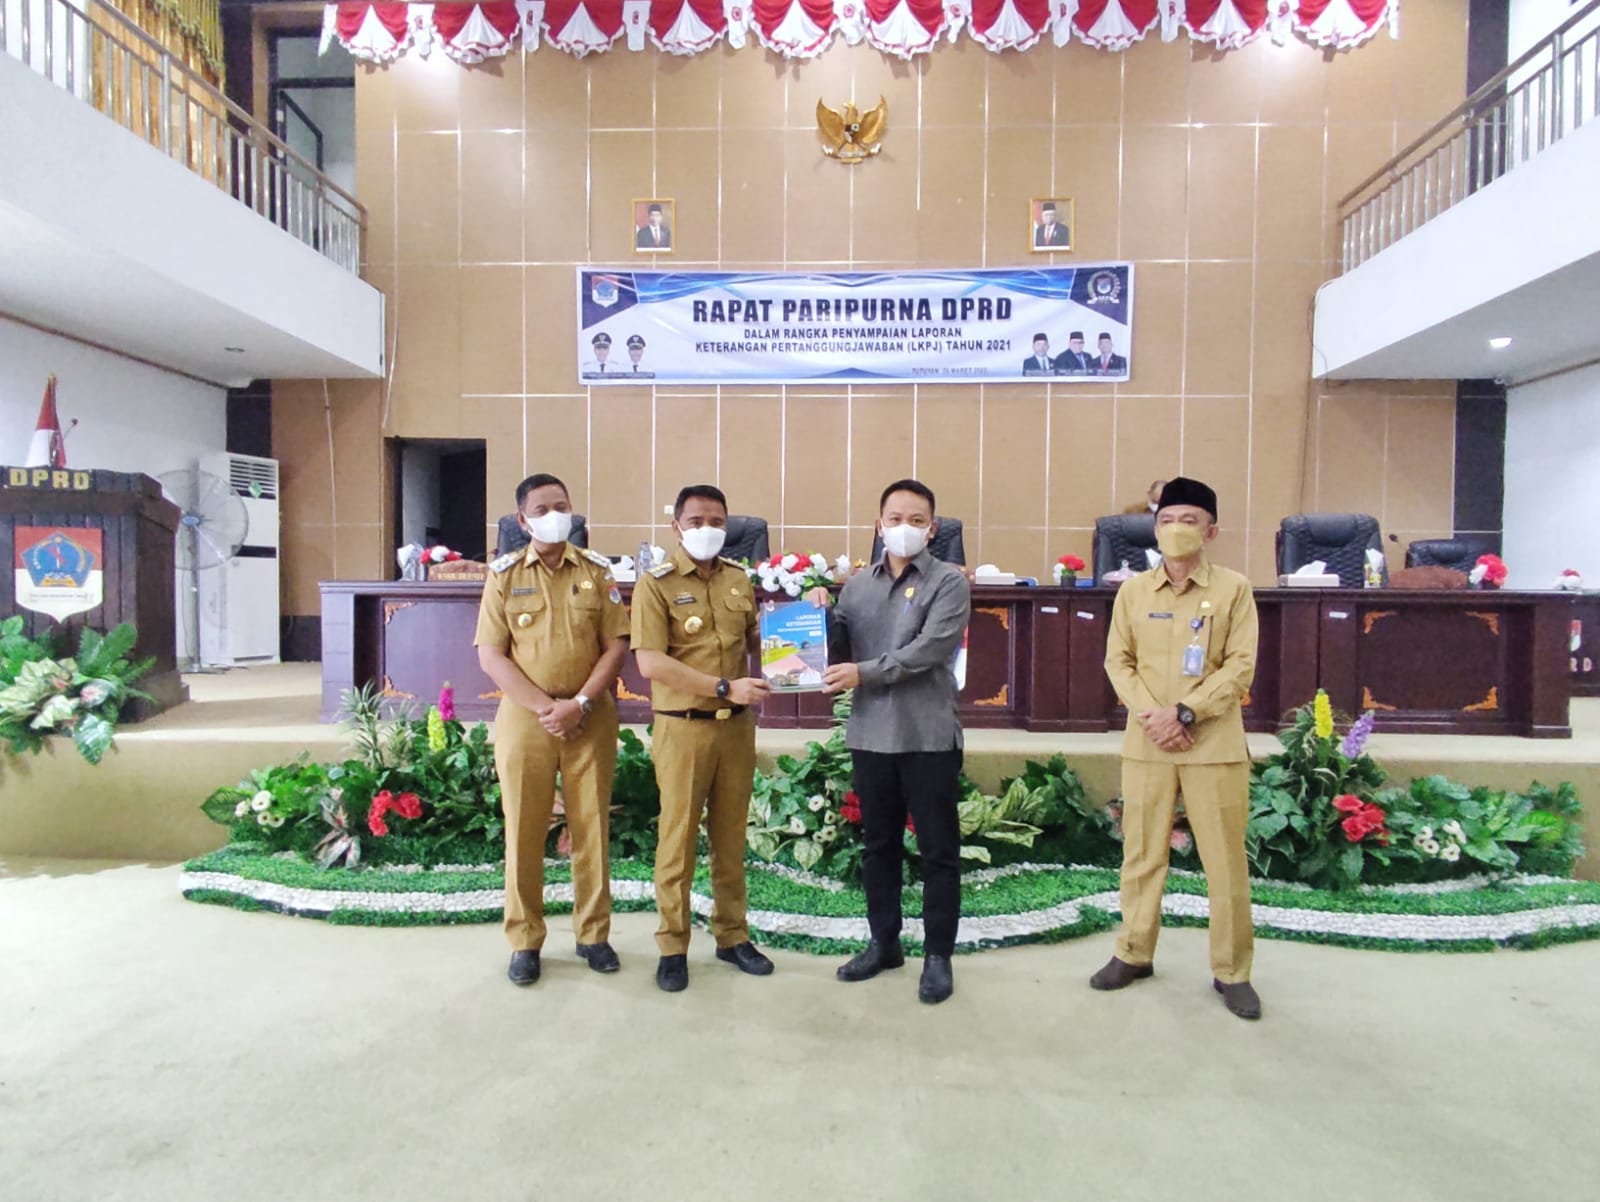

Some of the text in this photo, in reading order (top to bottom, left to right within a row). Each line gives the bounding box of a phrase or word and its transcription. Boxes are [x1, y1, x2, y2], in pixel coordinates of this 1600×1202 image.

[693, 297, 1012, 322] RAPAT PARIPURNA DPRD
[744, 327, 962, 338] DALAM RANGKA PENYAMPAIAN LAPORAN
[695, 339, 1011, 353] KETERANGAN PERTANGGUNGJAWABAN (LKPJ) TAHUN 2021
[9, 468, 90, 490] DPRD
